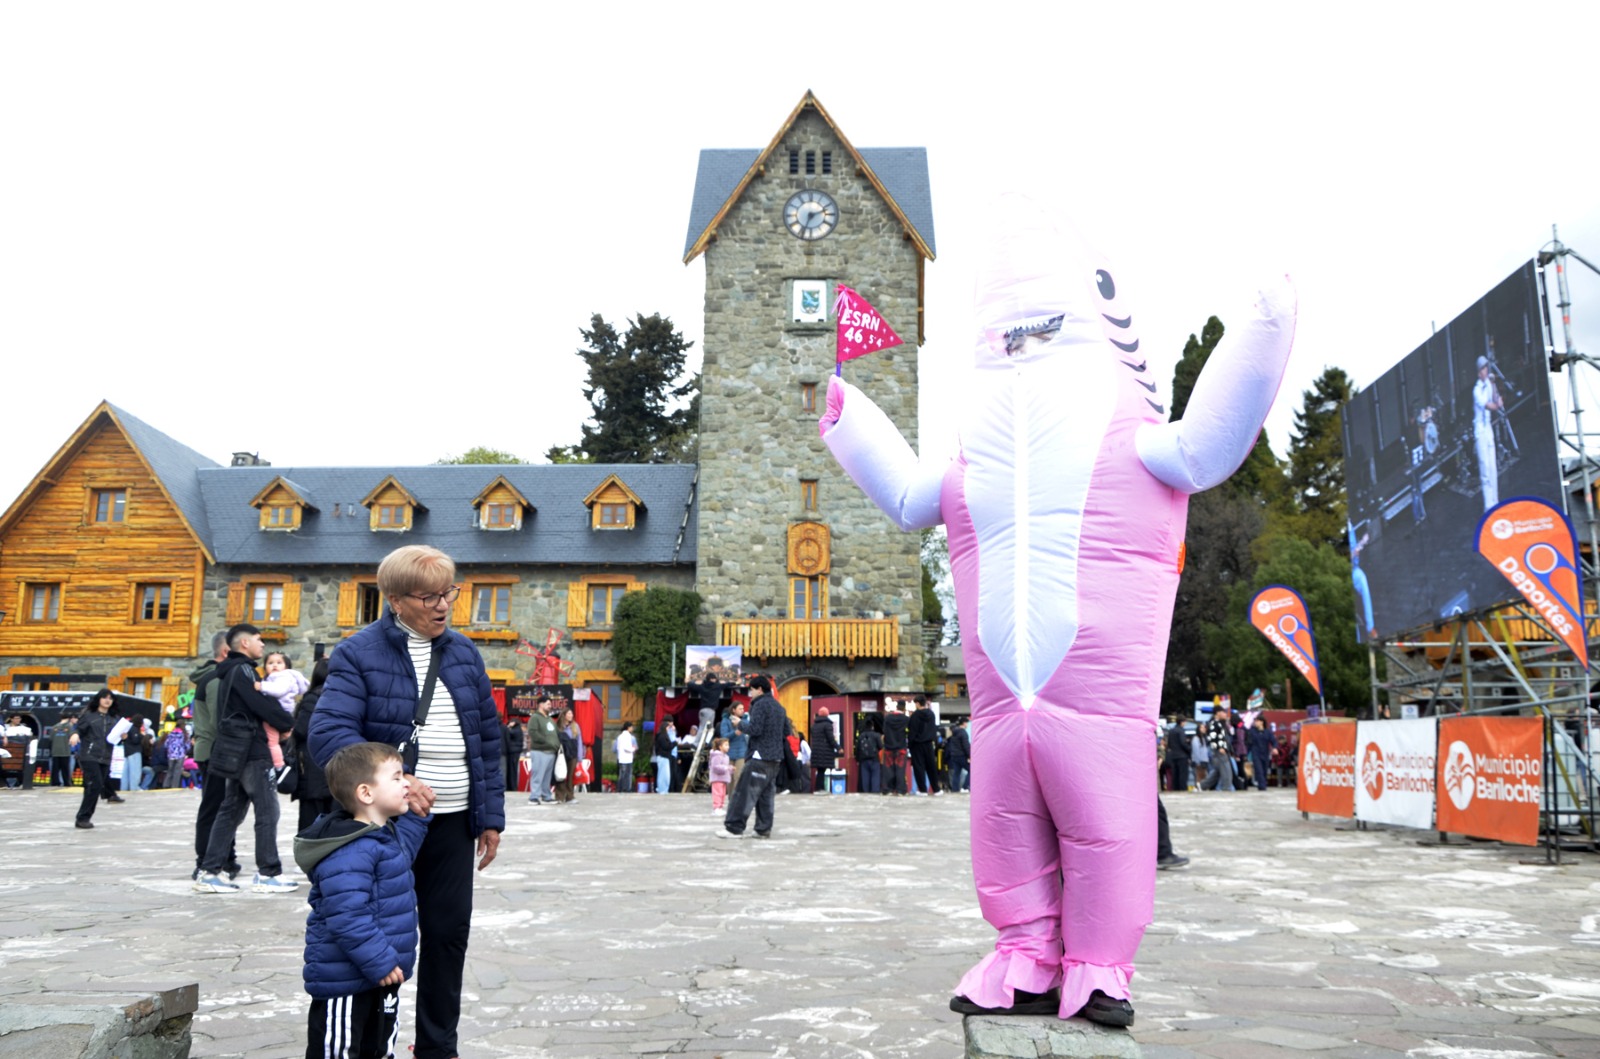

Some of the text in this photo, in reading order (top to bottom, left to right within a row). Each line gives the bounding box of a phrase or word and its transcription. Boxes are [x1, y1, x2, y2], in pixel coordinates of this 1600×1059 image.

[840, 309, 880, 331] ESRN
[844, 327, 863, 343] 46
[1499, 556, 1574, 637] Deportes
[1263, 623, 1310, 675] Deportes
[512, 698, 537, 710] MOULI
[1386, 751, 1435, 771] Municipio
[1475, 752, 1540, 779] Municipio
[1320, 763, 1356, 787] Bariloche
[1386, 771, 1435, 792] Bariloche
[1476, 776, 1540, 804] Bariloche
